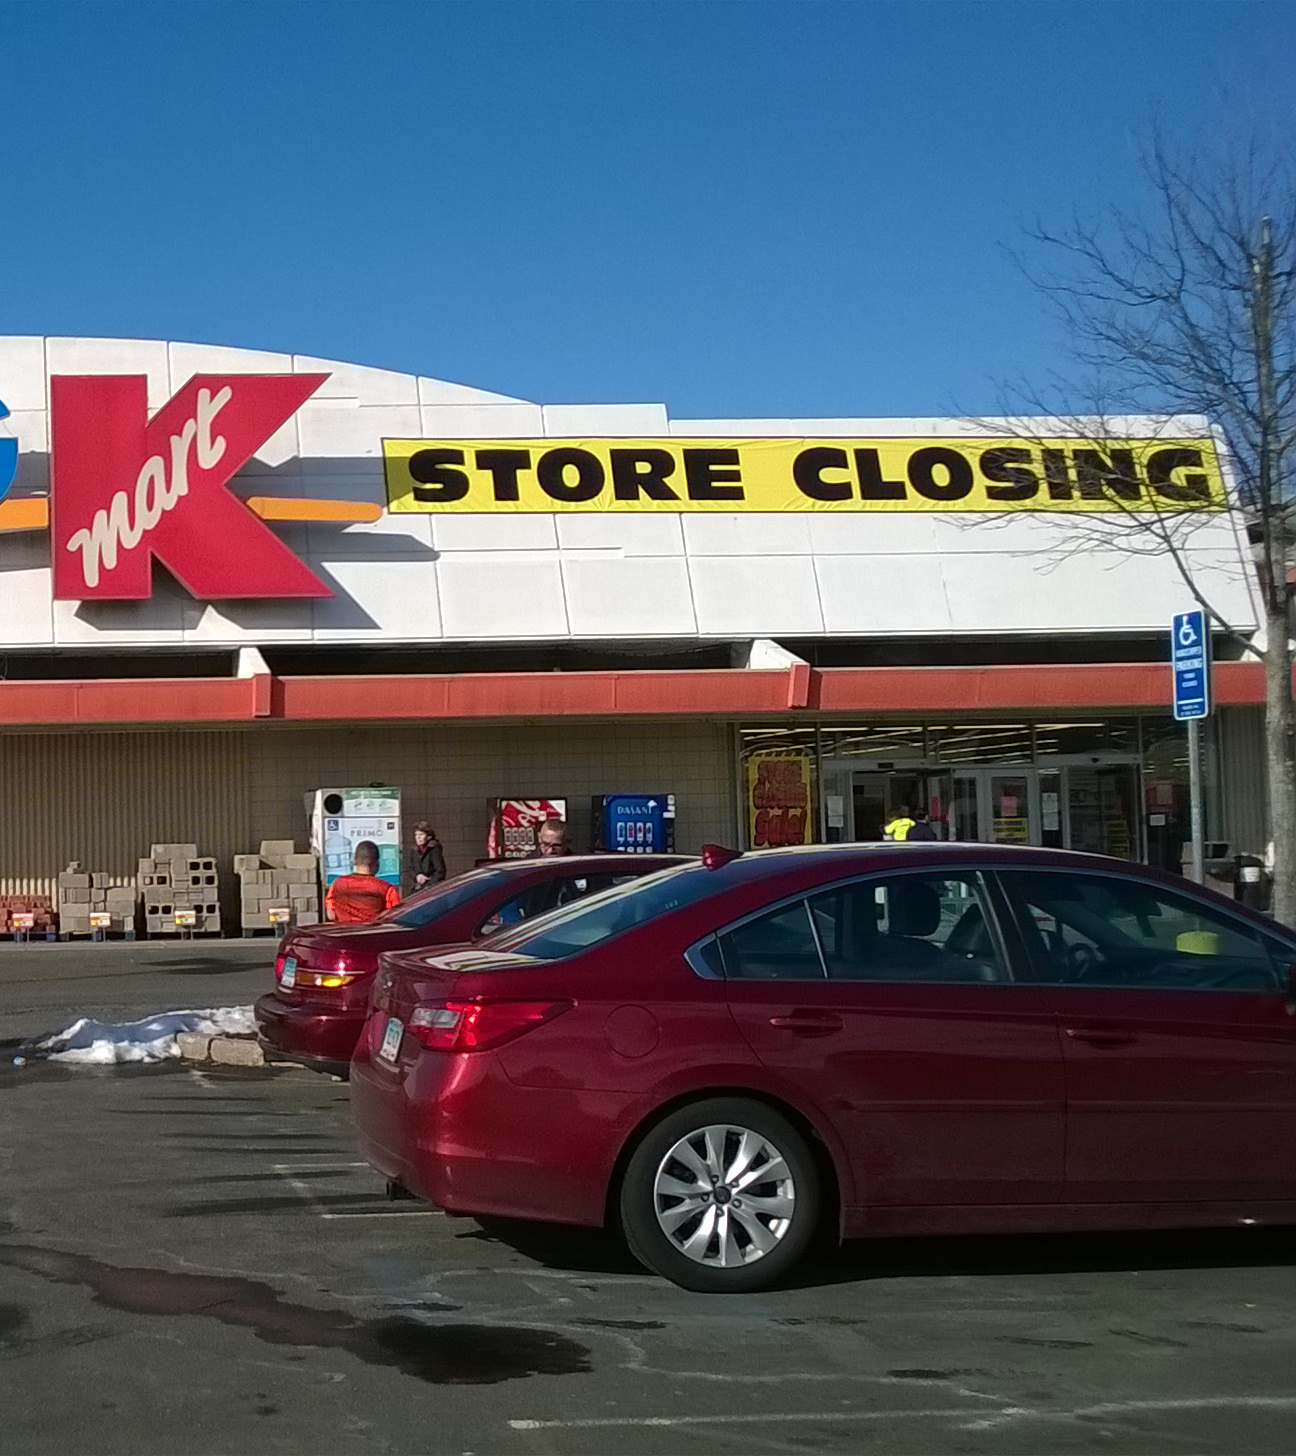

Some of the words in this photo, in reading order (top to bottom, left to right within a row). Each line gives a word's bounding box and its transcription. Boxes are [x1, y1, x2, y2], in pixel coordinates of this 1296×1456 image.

[51, 373, 335, 601] K
[66, 385, 233, 588] mart
[408, 447, 746, 503] STORE
[792, 446, 1211, 501] CLOSING
[350, 829, 384, 837] PRIMO
